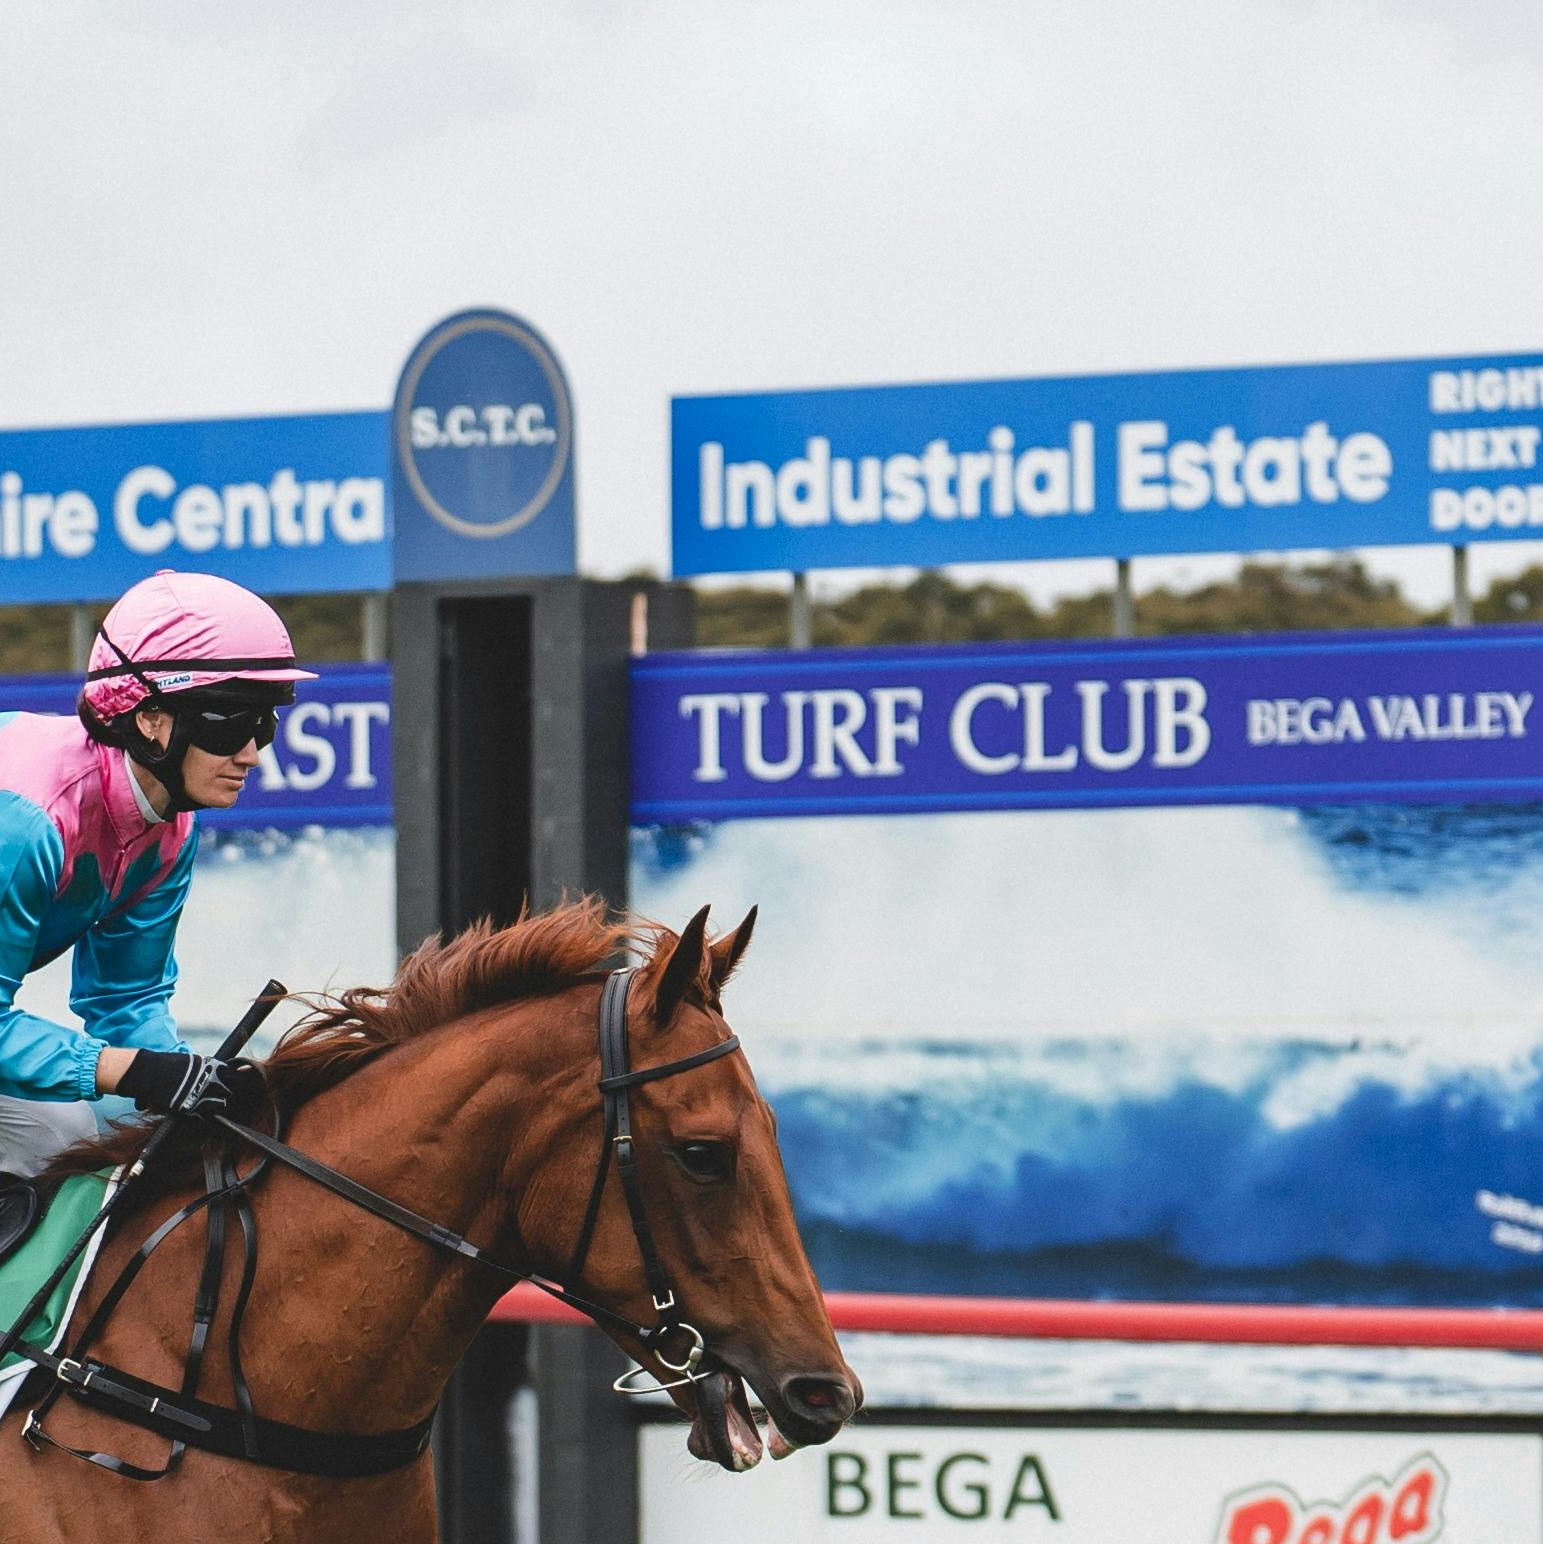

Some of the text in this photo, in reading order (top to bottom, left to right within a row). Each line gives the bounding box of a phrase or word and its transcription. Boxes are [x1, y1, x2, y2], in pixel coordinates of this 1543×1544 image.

[411, 403, 557, 448] S.C.T.C.
[1429, 425, 1543, 474] NEXT
[698, 420, 1394, 530] Industrial Estate
[679, 676, 1534, 784] TURF CLUB BEGA VALLEY
[828, 1453, 1060, 1521] BEGA
